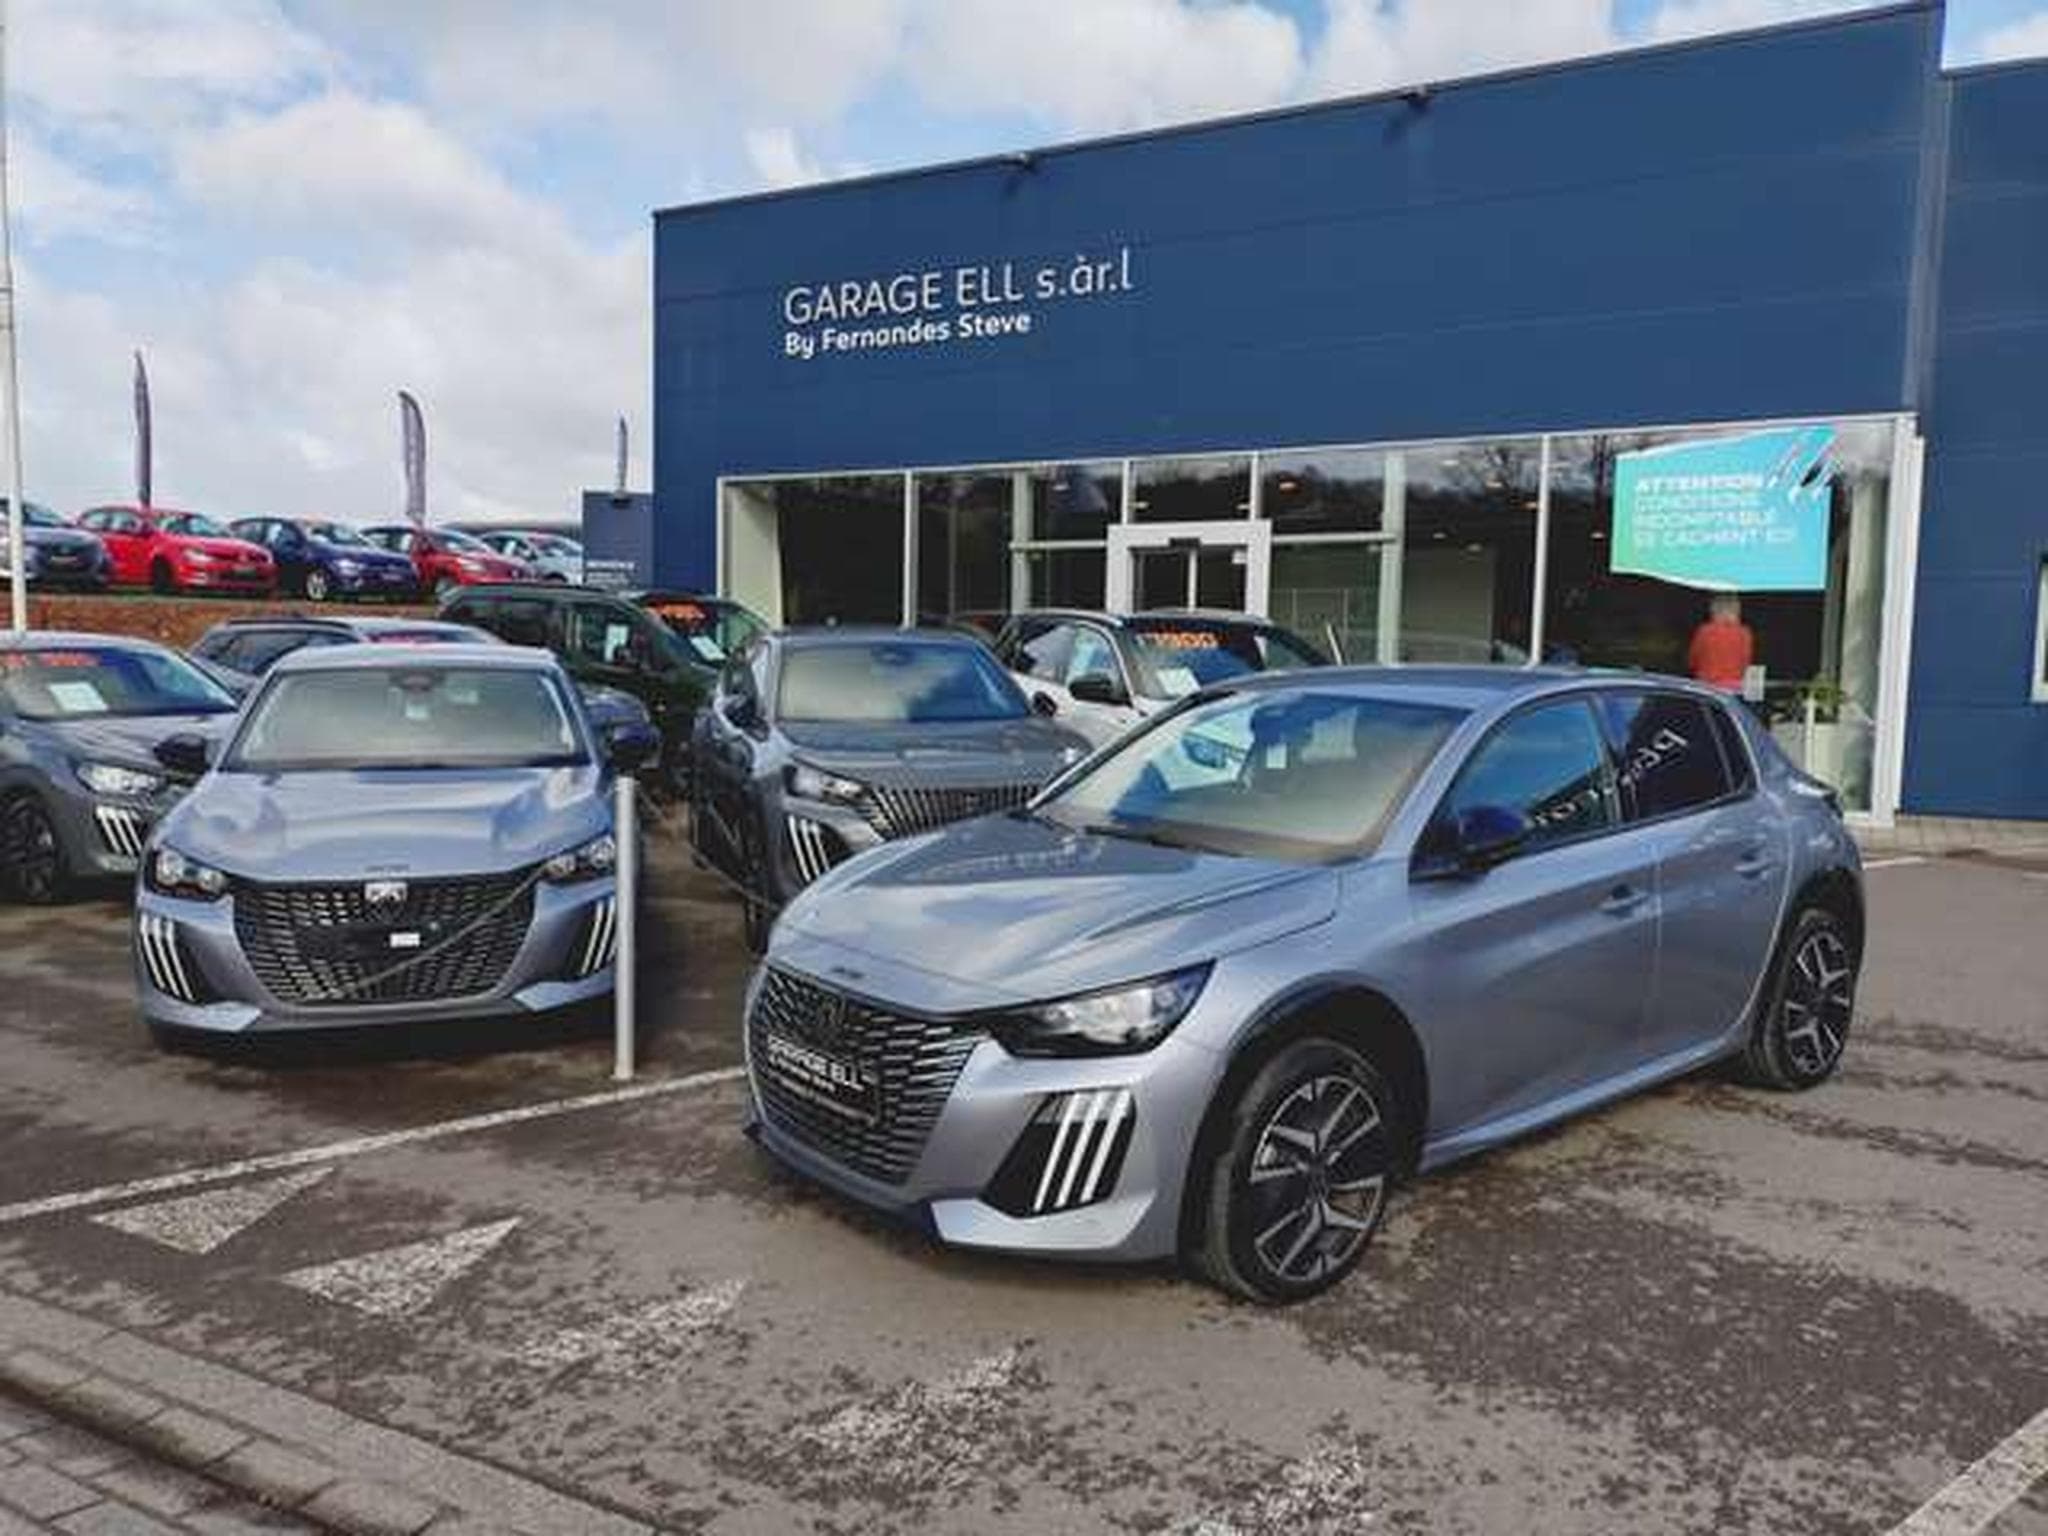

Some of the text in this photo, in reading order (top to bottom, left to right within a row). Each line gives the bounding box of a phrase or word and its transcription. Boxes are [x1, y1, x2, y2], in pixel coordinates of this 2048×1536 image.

[785, 271, 943, 325] GARAGE
[956, 263, 1025, 306] ELL
[785, 311, 1032, 360] By Fernandes Steve
[1635, 472, 1765, 492] ATTENTION
